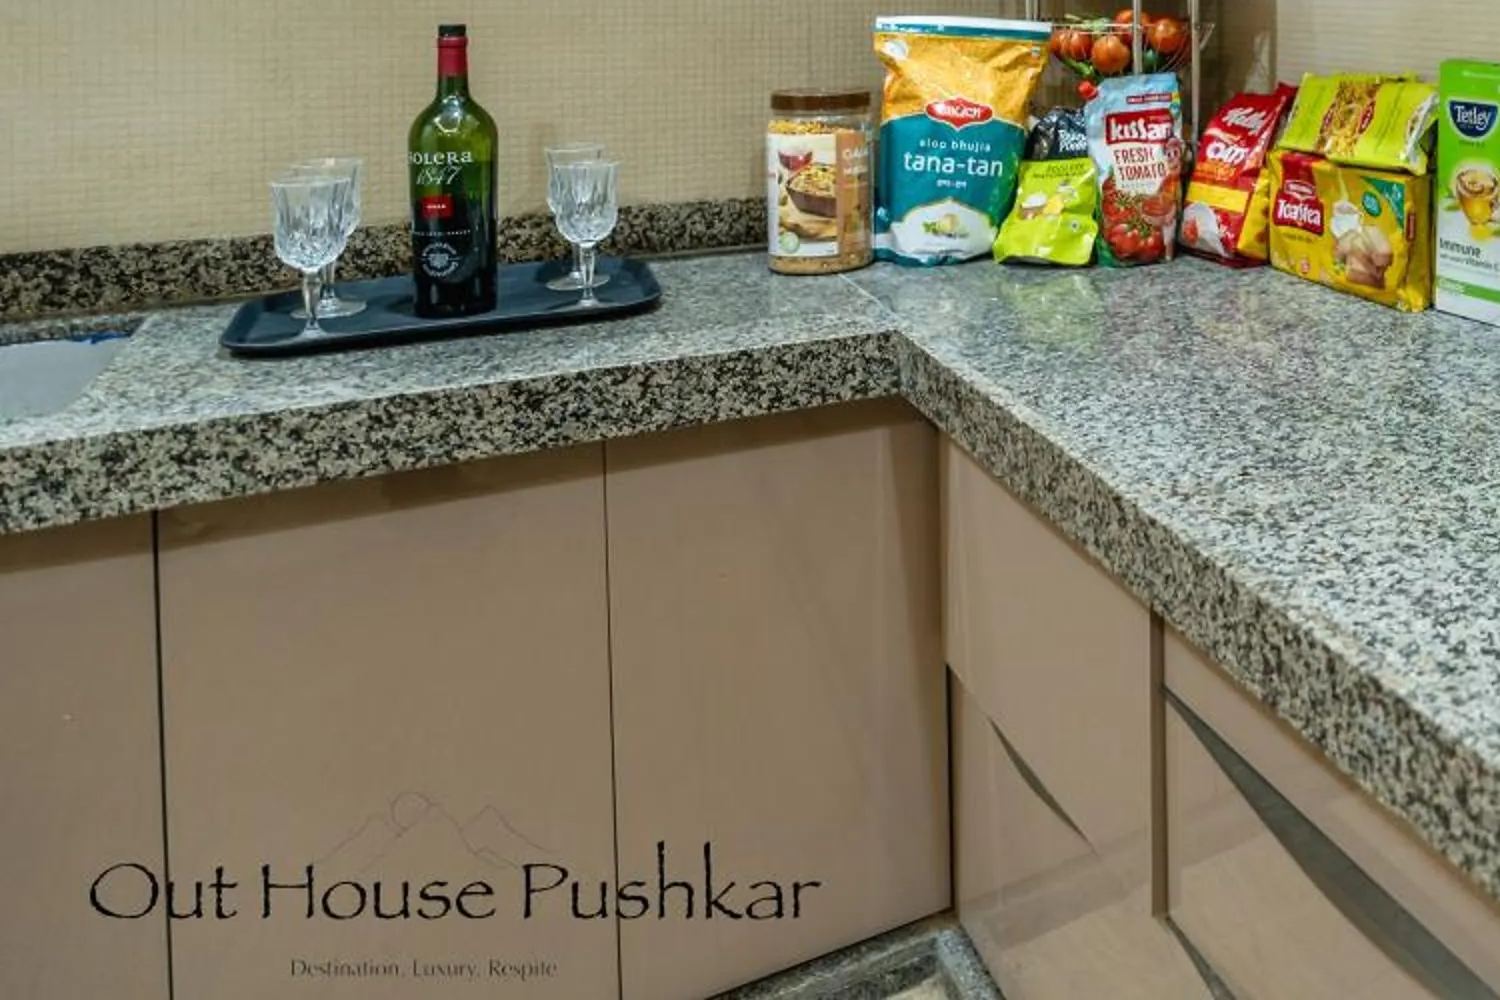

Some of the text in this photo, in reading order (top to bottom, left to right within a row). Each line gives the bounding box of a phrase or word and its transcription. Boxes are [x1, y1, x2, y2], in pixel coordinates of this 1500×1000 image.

[1453, 104, 1492, 131] Tetley
[919, 137, 991, 153] aloo bhujia
[903, 151, 1003, 177] tana-tan
[1113, 147, 1155, 164] FRESH
[1118, 161, 1166, 181] TOMATO
